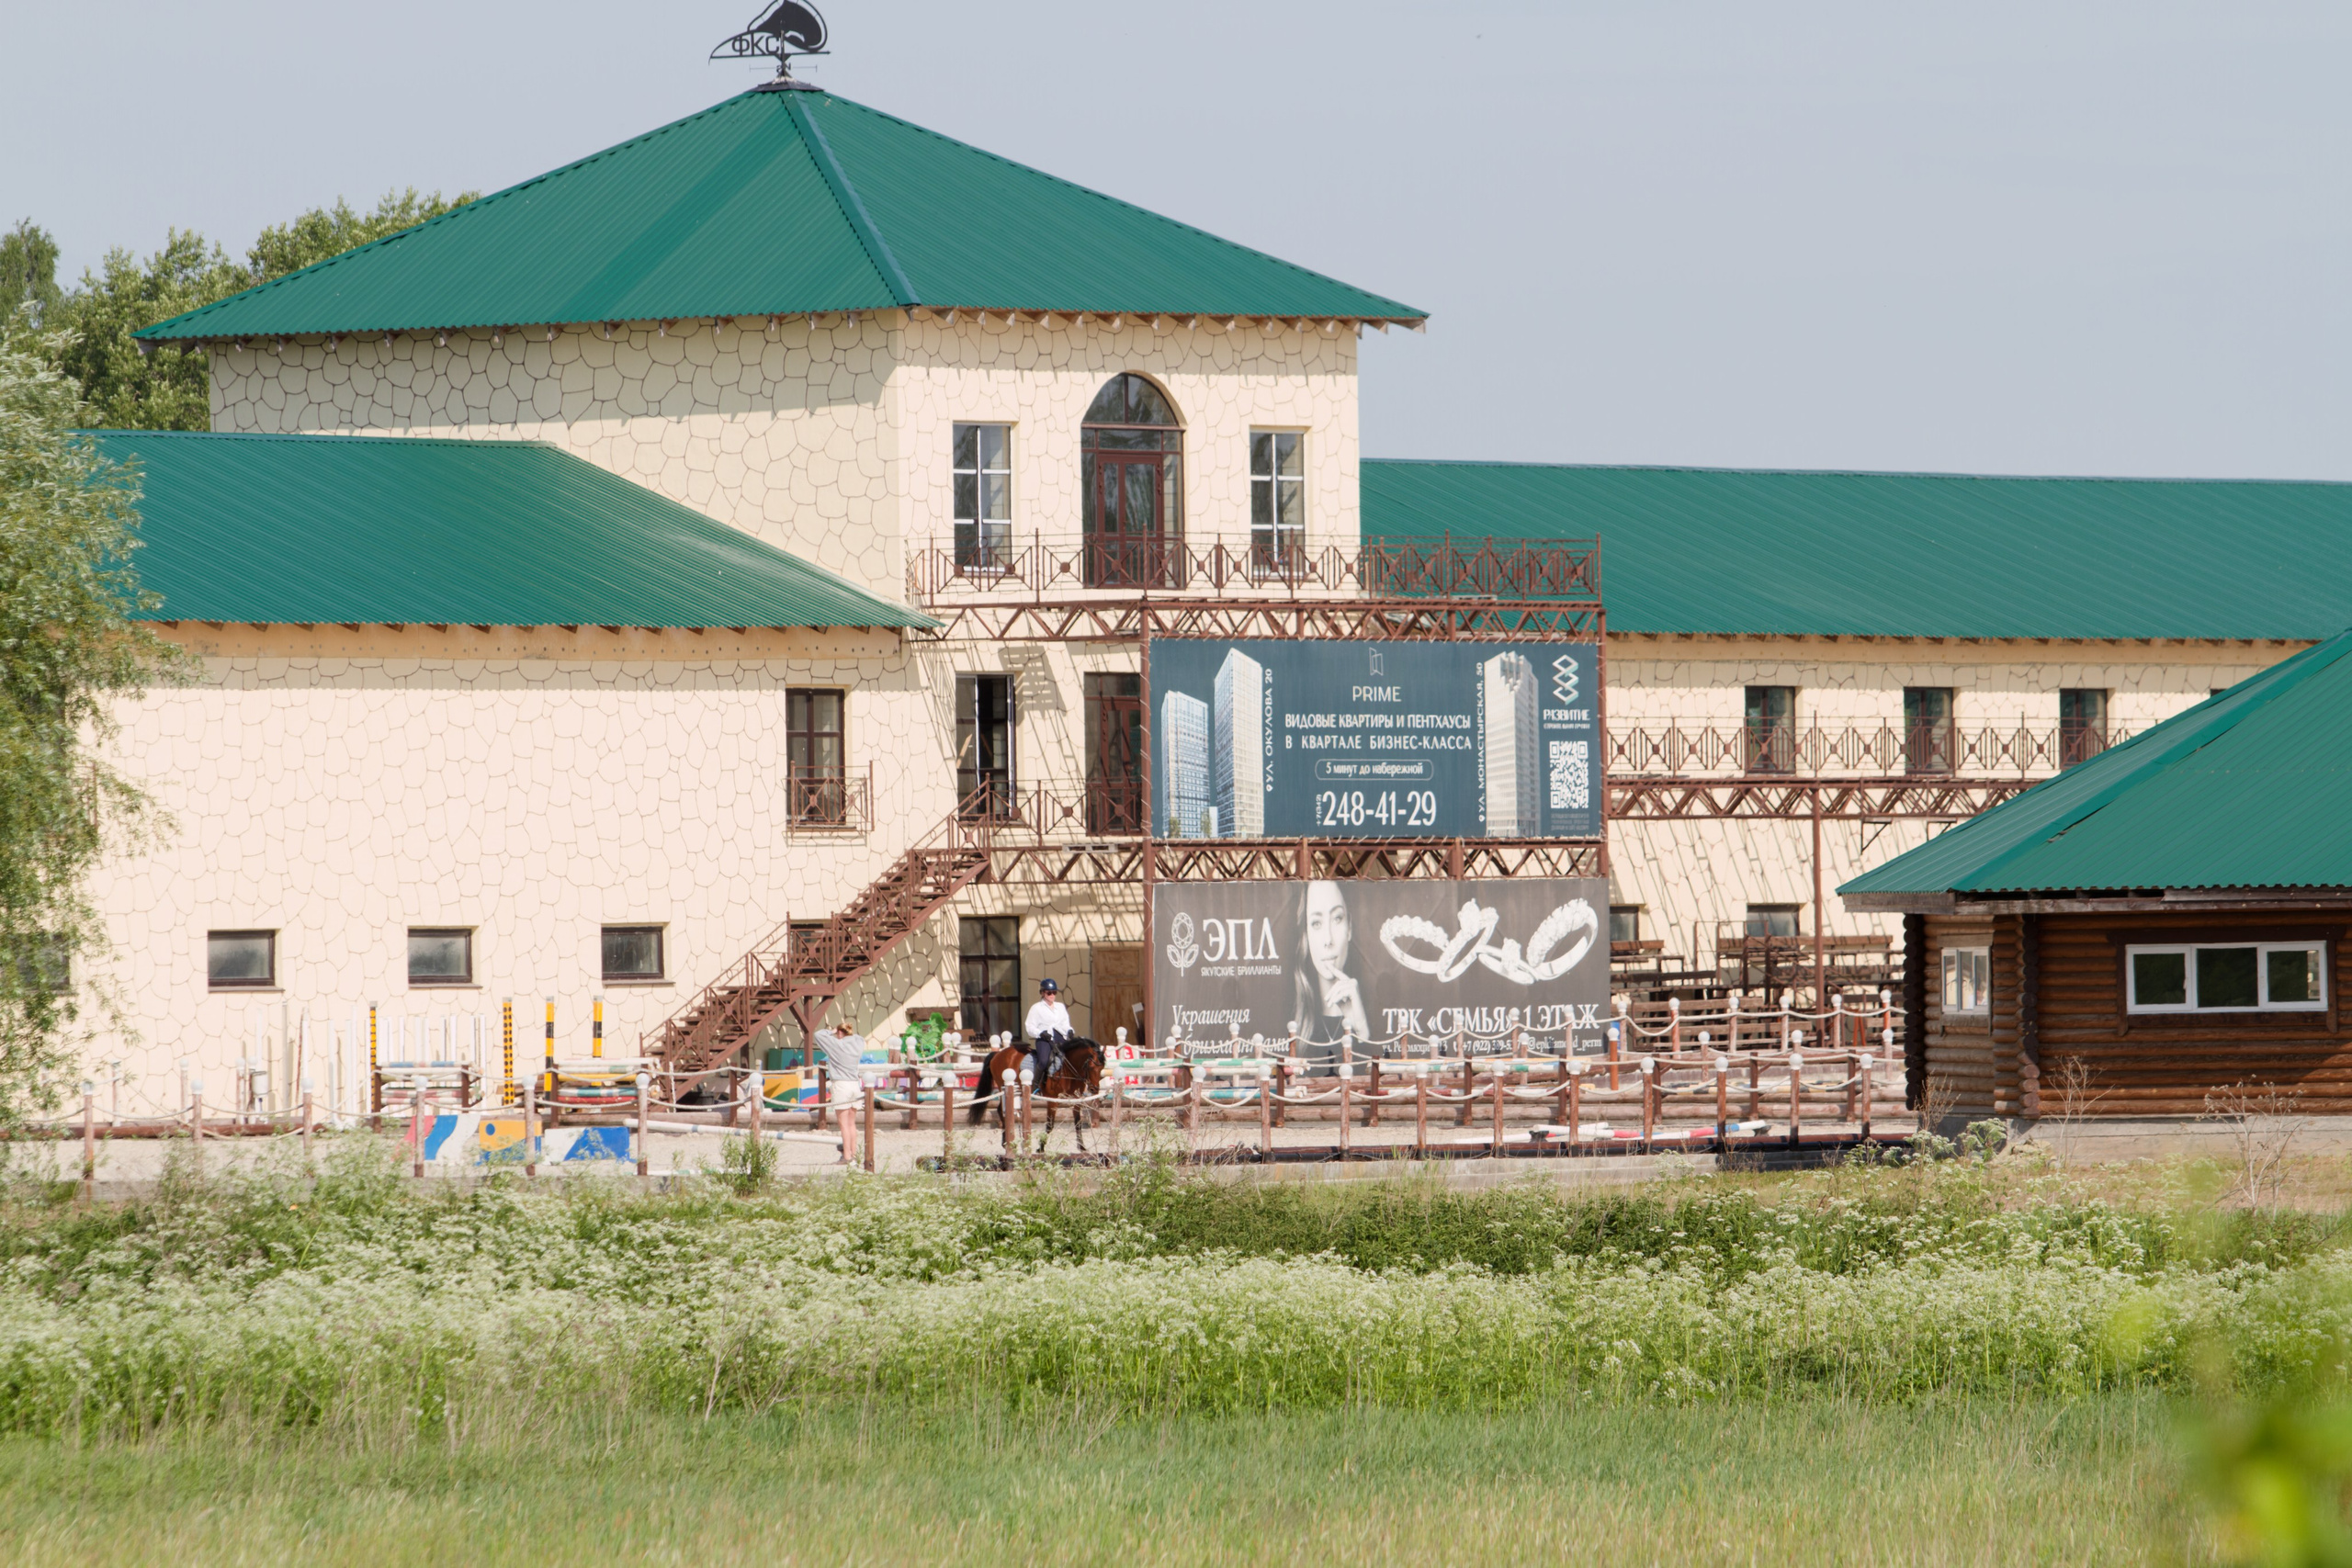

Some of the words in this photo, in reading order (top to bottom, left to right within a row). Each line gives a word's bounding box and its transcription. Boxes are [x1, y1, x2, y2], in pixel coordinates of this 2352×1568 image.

[731, 32, 780, 56] ФКС
[1264, 668, 1273, 683] 20
[1352, 686, 1402, 702] PRIME
[1264, 688, 1273, 757] ОКУЛОВА
[1285, 714, 1337, 729] ВИДОВЫЕ
[1339, 714, 1394, 728] КВАРТИРЫ
[1396, 715, 1405, 728] И
[1407, 715, 1471, 729] ПЕНТХАУСЫ
[1543, 709, 1591, 721] РАЗВИТИЕ
[1285, 735, 1293, 750] В
[1301, 735, 1362, 750] КВАРТАЛЕ
[1370, 735, 1472, 750] БИЗНЕС-КЛАССА
[1265, 761, 1273, 783] УЛ.
[1326, 761, 1331, 774] 5
[1333, 763, 1358, 777] минут
[1359, 763, 1371, 775] до
[1372, 761, 1423, 777] набережной
[1322, 791, 1437, 826] 248-41-29
[1203, 917, 1279, 962] ЭПЛ
[1201, 965, 1235, 976] ЯКУТСКИЕ
[1237, 965, 1282, 976] БРИЛЛИАНТЫ
[1172, 1004, 1250, 1031] Украшения
